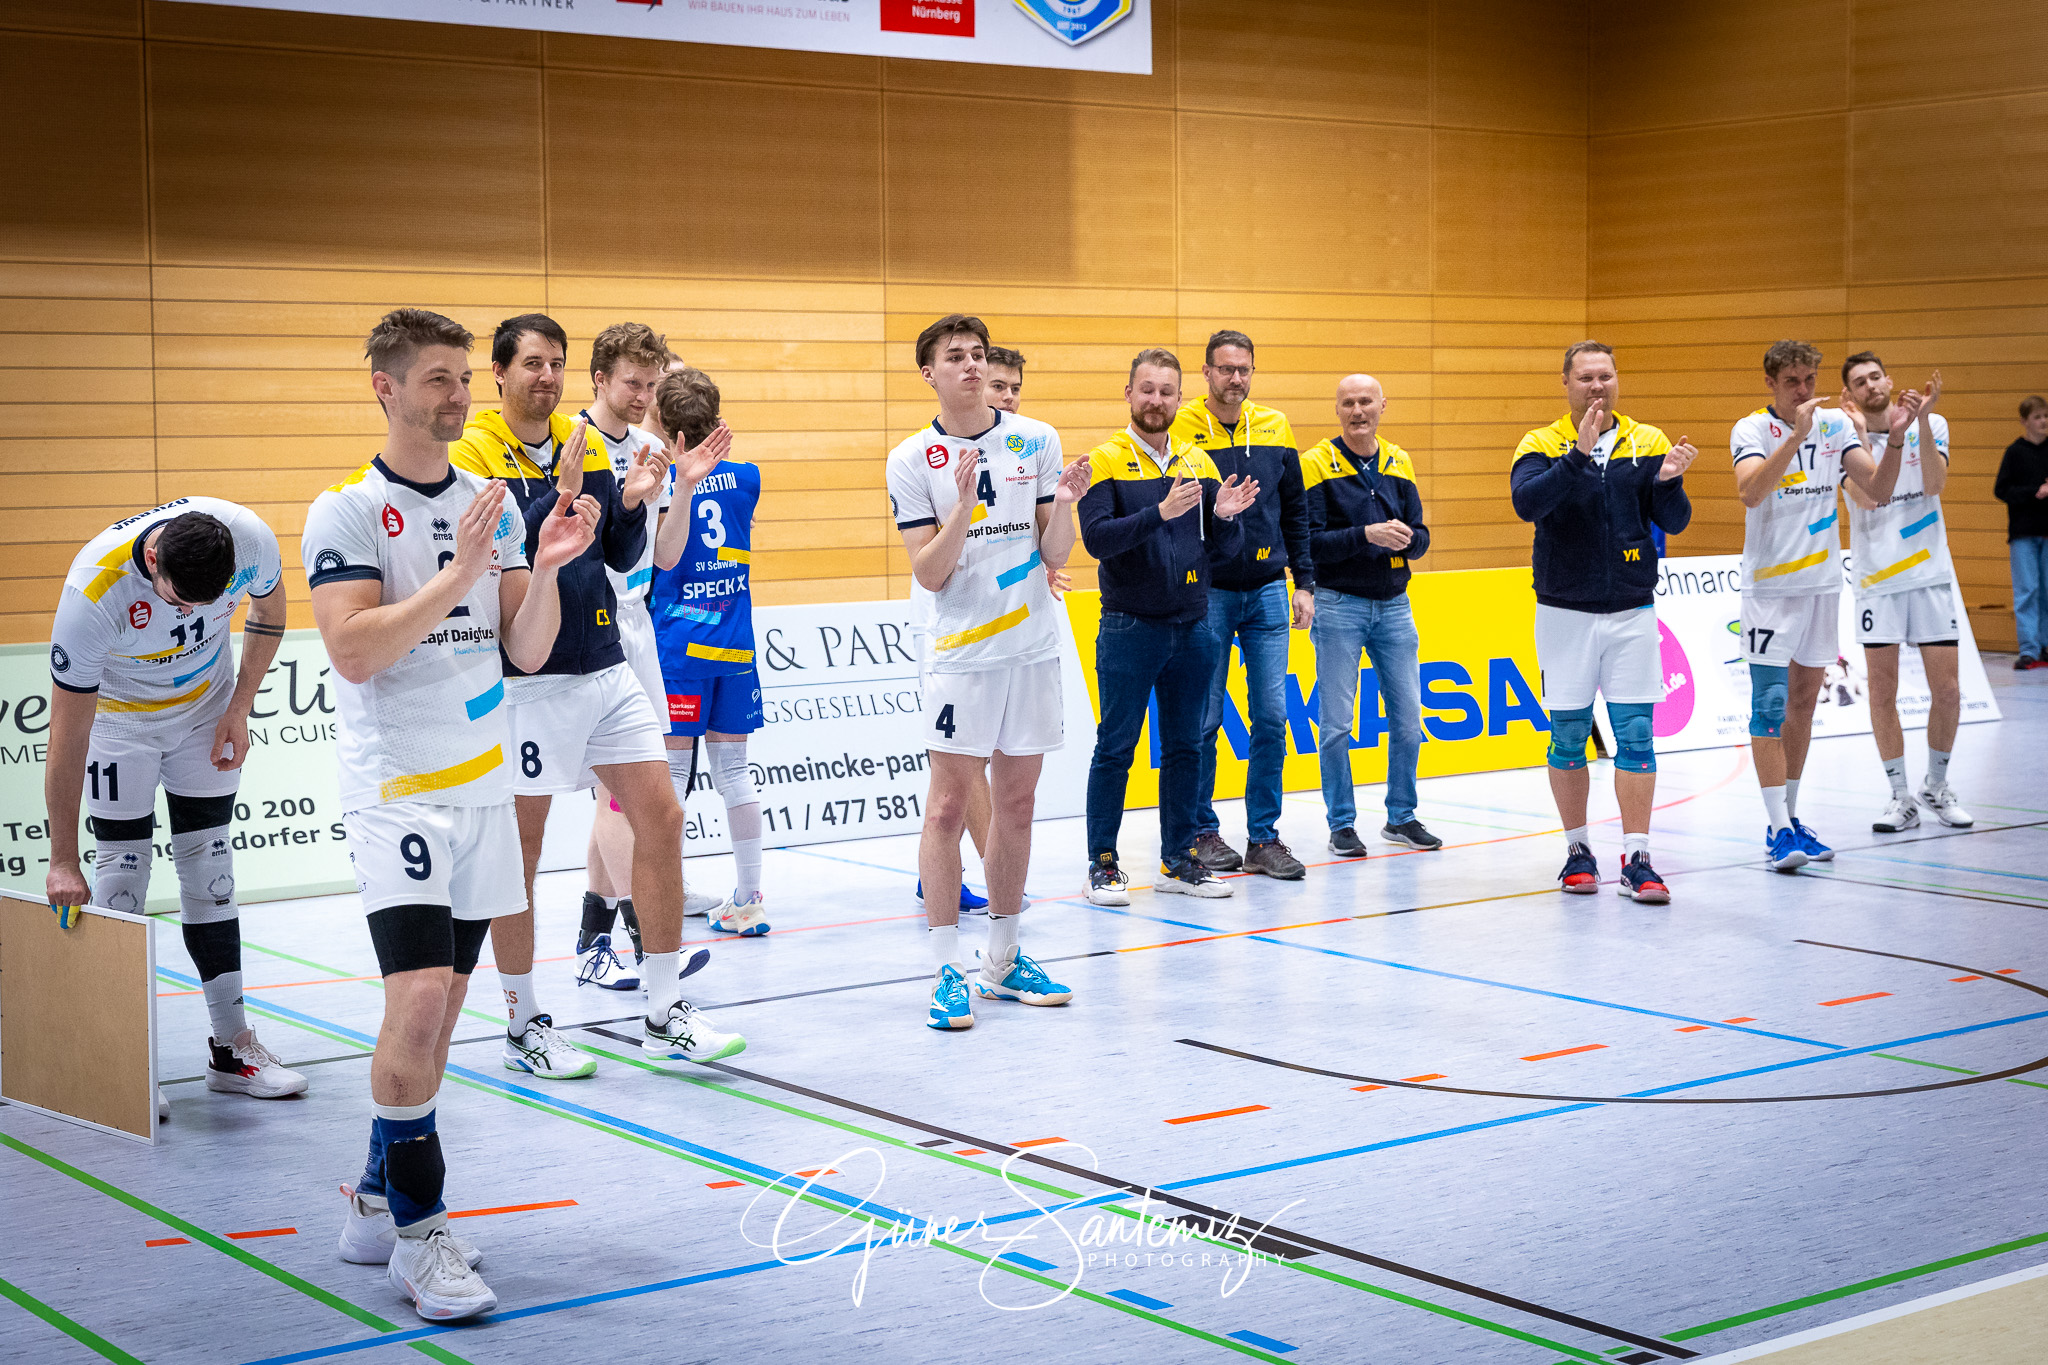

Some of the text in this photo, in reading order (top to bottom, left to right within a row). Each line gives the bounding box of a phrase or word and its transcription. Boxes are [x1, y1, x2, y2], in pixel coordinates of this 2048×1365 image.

[709, 1, 745, 14] BAUEN
[746, 5, 764, 15] IHR
[765, 6, 794, 18] HAUS
[795, 7, 818, 20] ZUM
[819, 10, 850, 22] LEBEN
[911, 5, 961, 24] Nürnberg
[976, 470, 997, 508] 4
[698, 499, 727, 549] 3
[985, 522, 1031, 535] Daigfuss
[432, 532, 454, 541] errea
[695, 557, 738, 572] SV Schwaig
[1622, 548, 1641, 562] YK
[682, 577, 735, 600] SPECK
[1185, 570, 1199, 585] AL
[1654, 562, 1743, 597] chnarc
[596, 608, 611, 626] CS
[683, 599, 735, 619] pumpe
[1861, 609, 1874, 632] 6
[169, 615, 205, 648] 11
[1747, 627, 1775, 654] 17
[765, 622, 917, 672] & PAR
[935, 703, 956, 739] 4
[1148, 657, 1552, 770] KASA
[520, 740, 543, 779] 8
[87, 760, 119, 802] 11
[262, 797, 316, 820] 200
[804, 803, 811, 831] /
[821, 798, 866, 826] 477
[876, 793, 922, 821] 581
[119, 861, 138, 870] errea
[400, 832, 432, 881] 9
